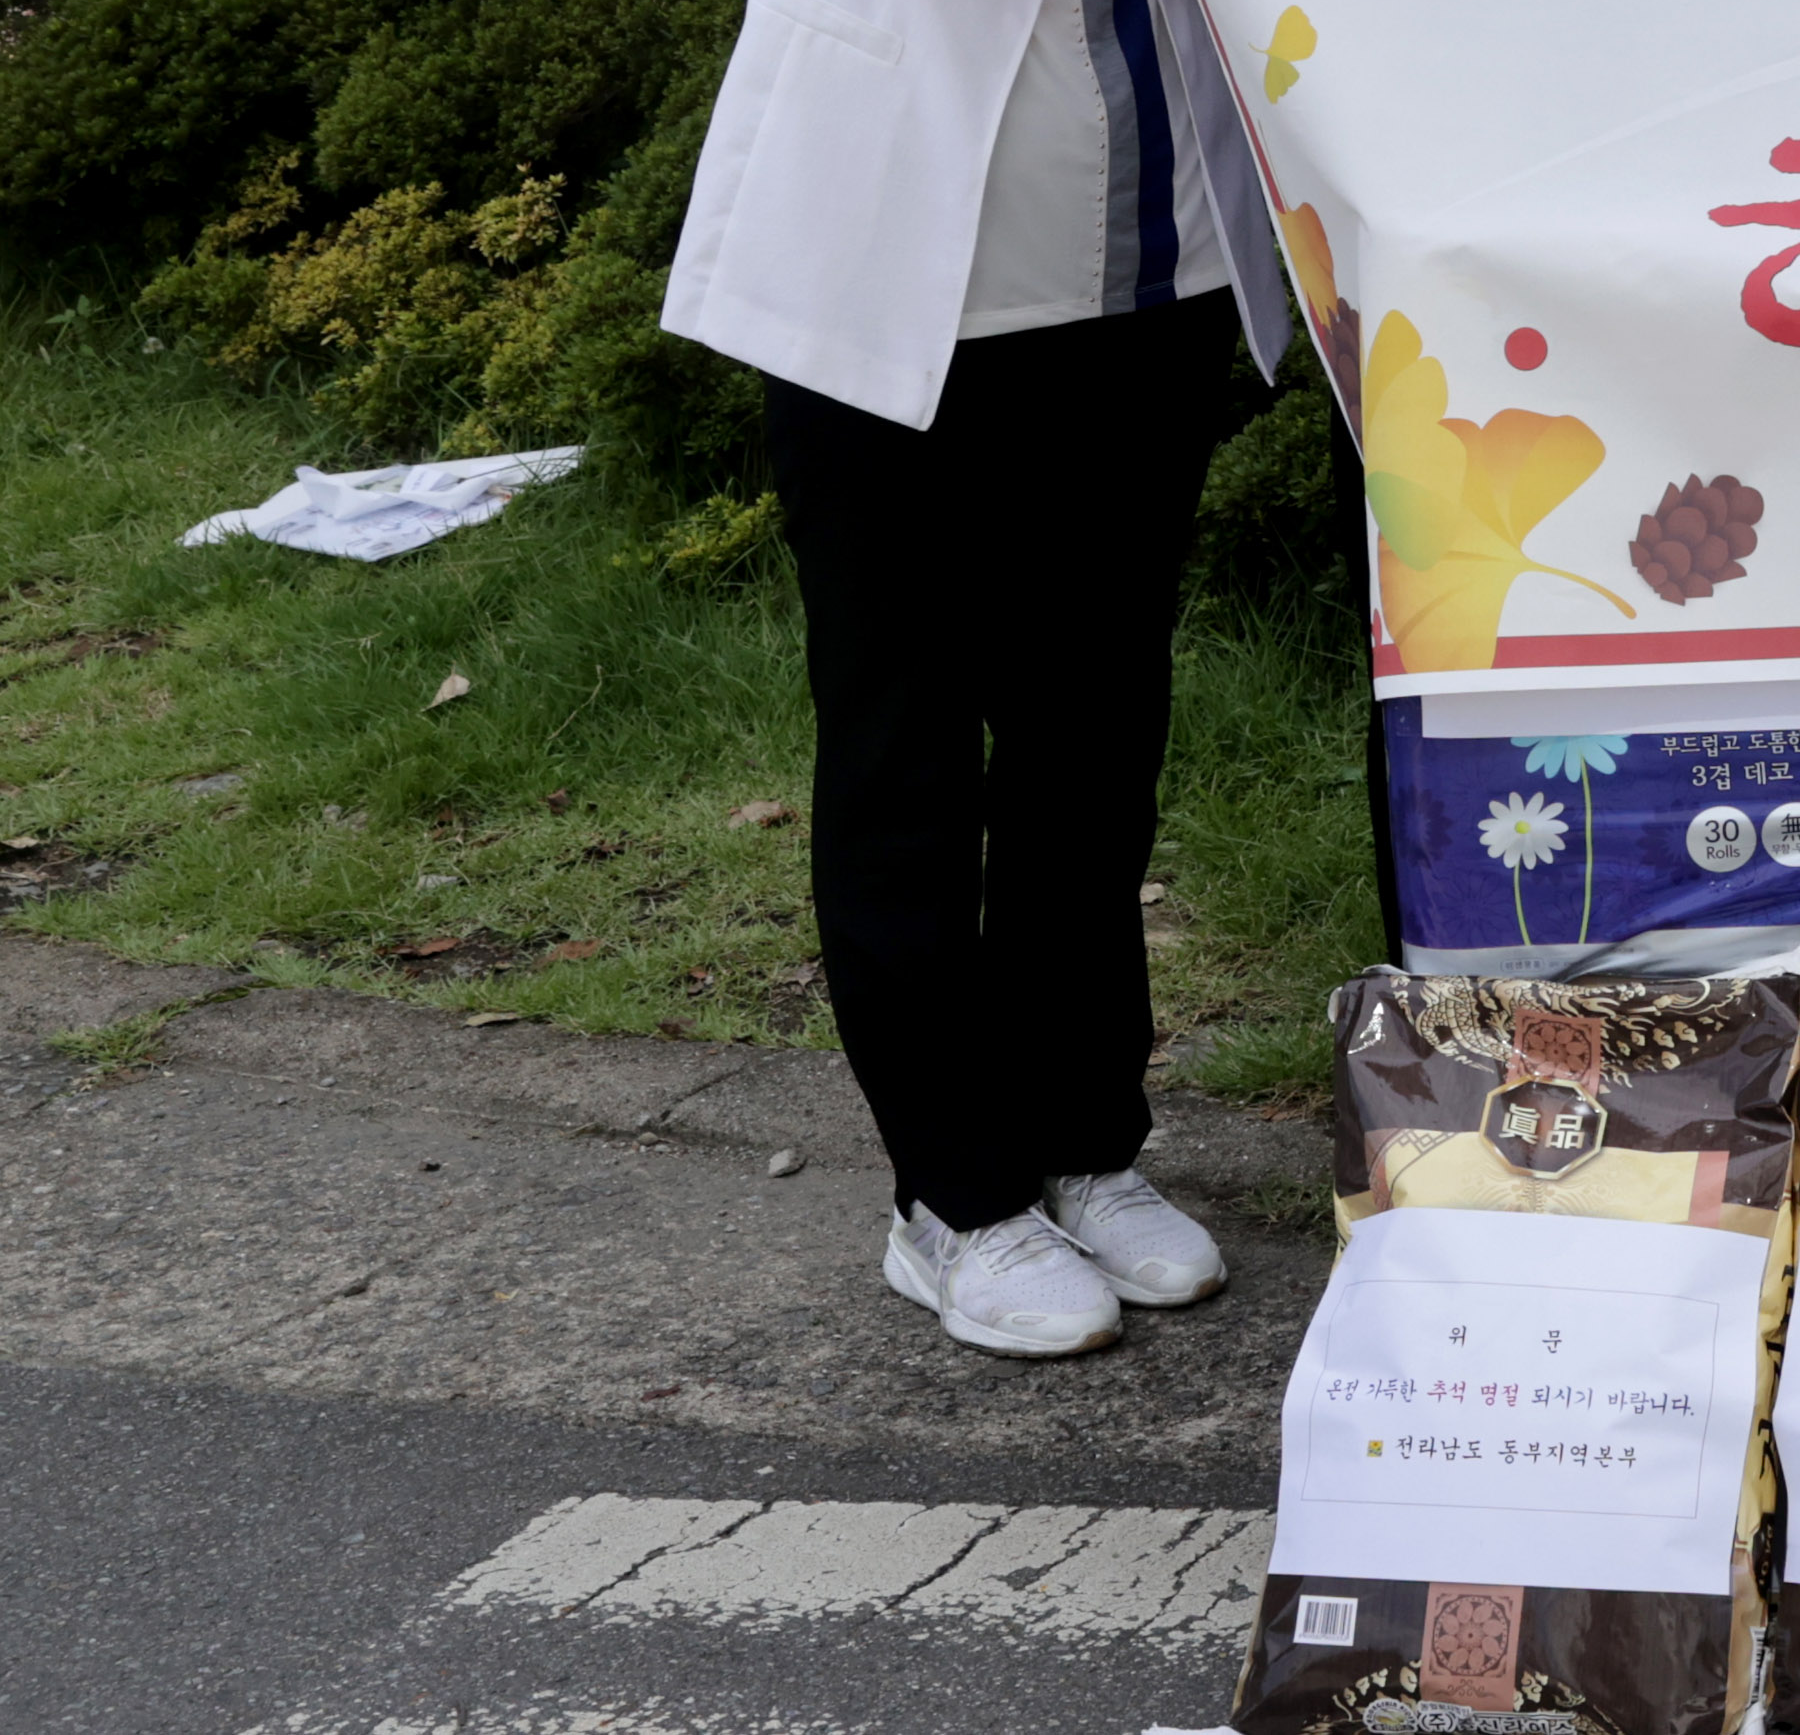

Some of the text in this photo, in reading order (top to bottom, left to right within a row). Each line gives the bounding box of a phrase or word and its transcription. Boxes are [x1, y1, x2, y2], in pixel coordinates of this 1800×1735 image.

[1659, 731, 1741, 758] 부드럽고
[1691, 762, 1732, 791] 3겹
[1743, 760, 1795, 786] 데코
[1704, 818, 1740, 844] 30
[1706, 844, 1741, 860] Rolls
[1325, 1376, 1697, 1418] 온정 가득한 추석 명절 되시기 바랍니다.
[1396, 1436, 1638, 1471] 전라남도 동부지역본부
